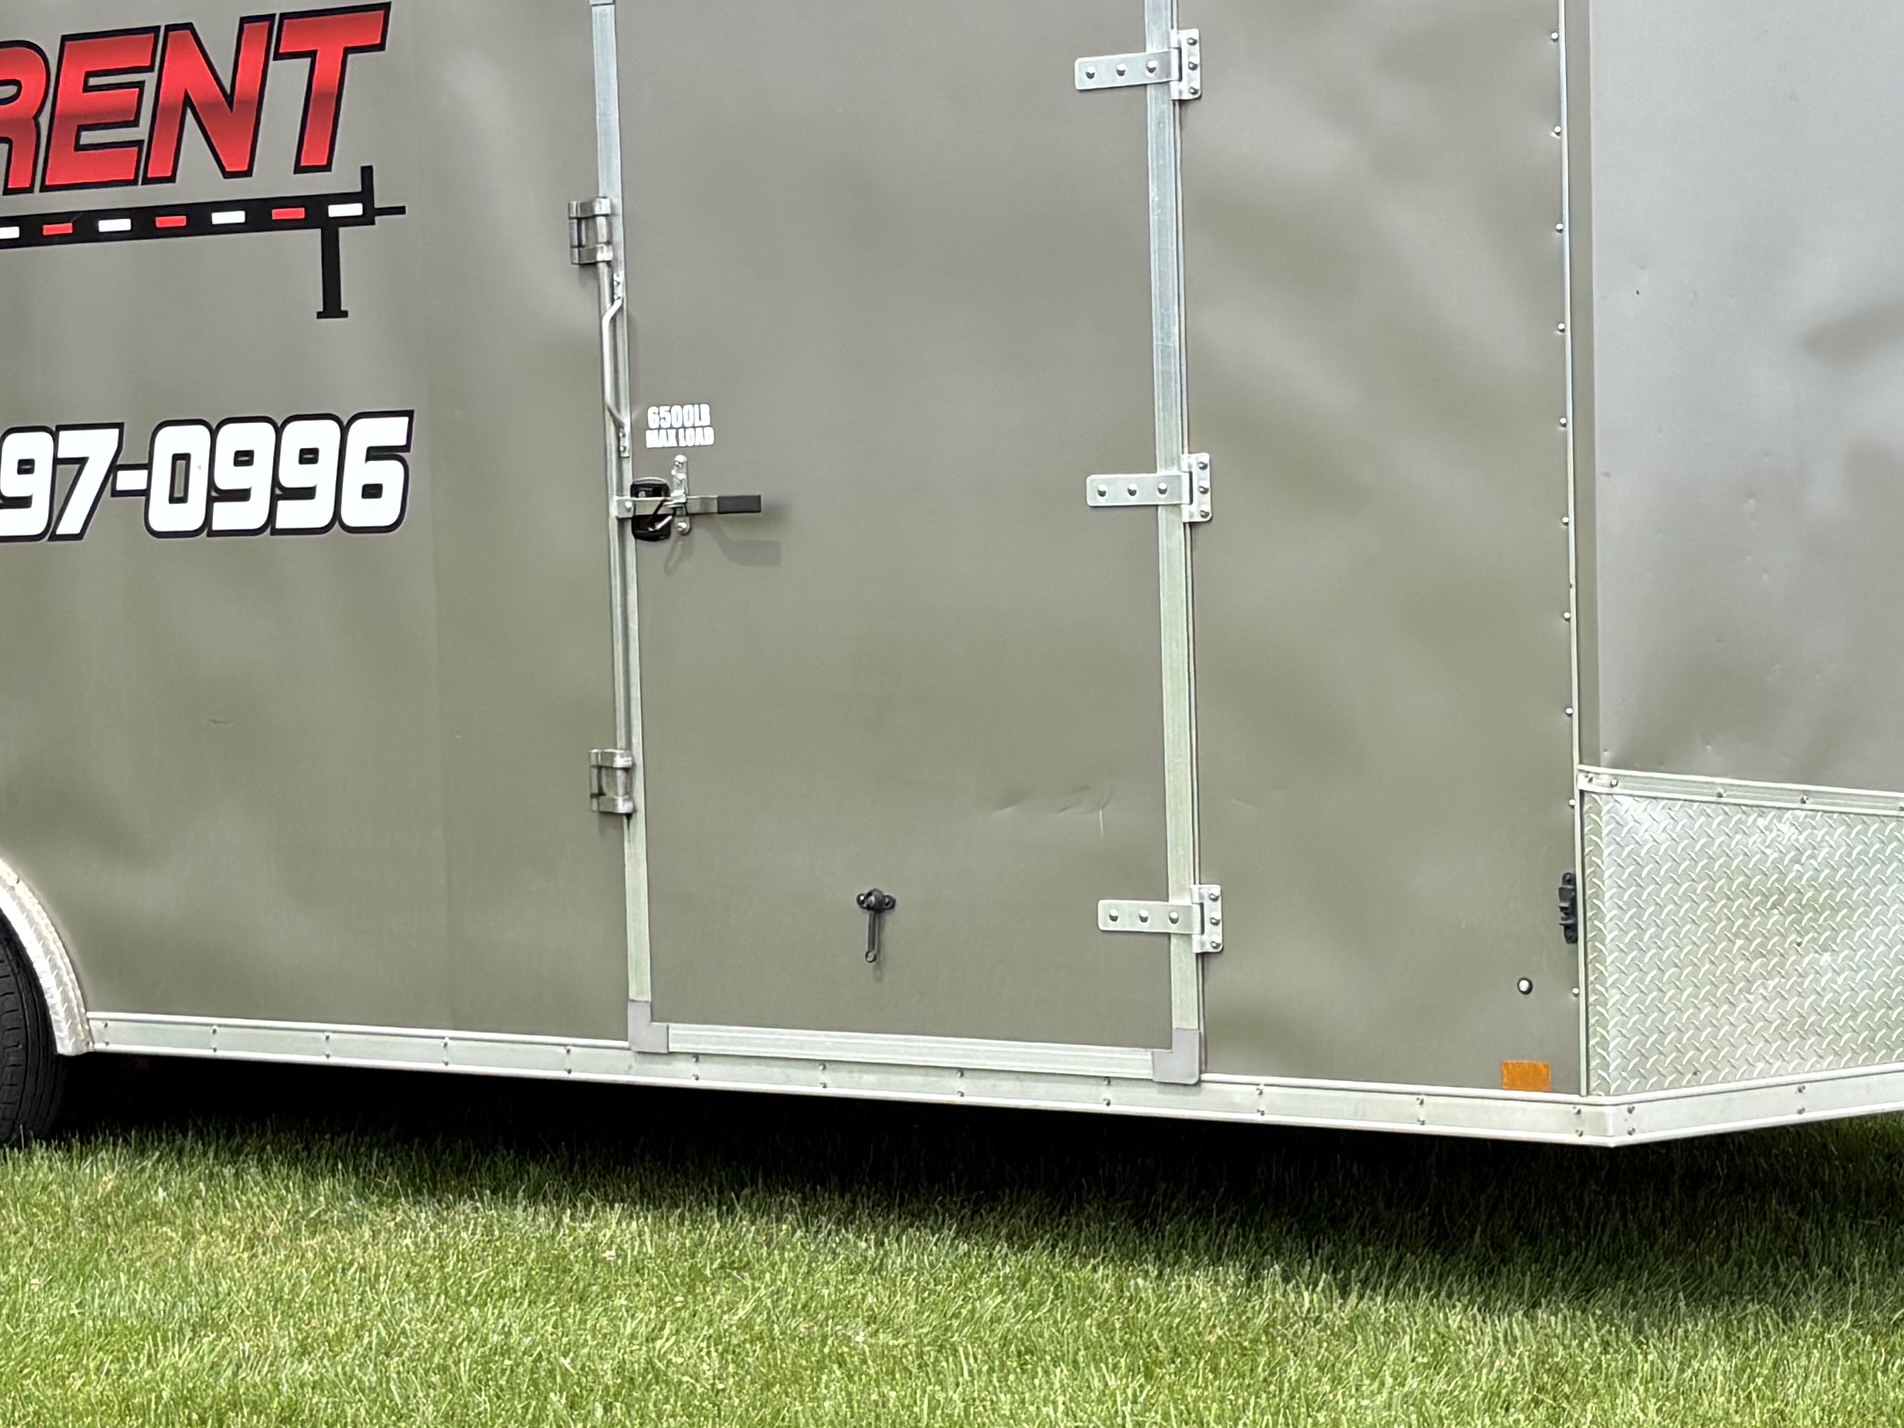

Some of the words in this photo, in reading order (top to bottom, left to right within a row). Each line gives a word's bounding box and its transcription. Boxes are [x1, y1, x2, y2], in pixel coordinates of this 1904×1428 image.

[647, 403, 711, 428] 6500LB
[645, 429, 678, 448] MAX
[678, 427, 715, 447] LOAD
